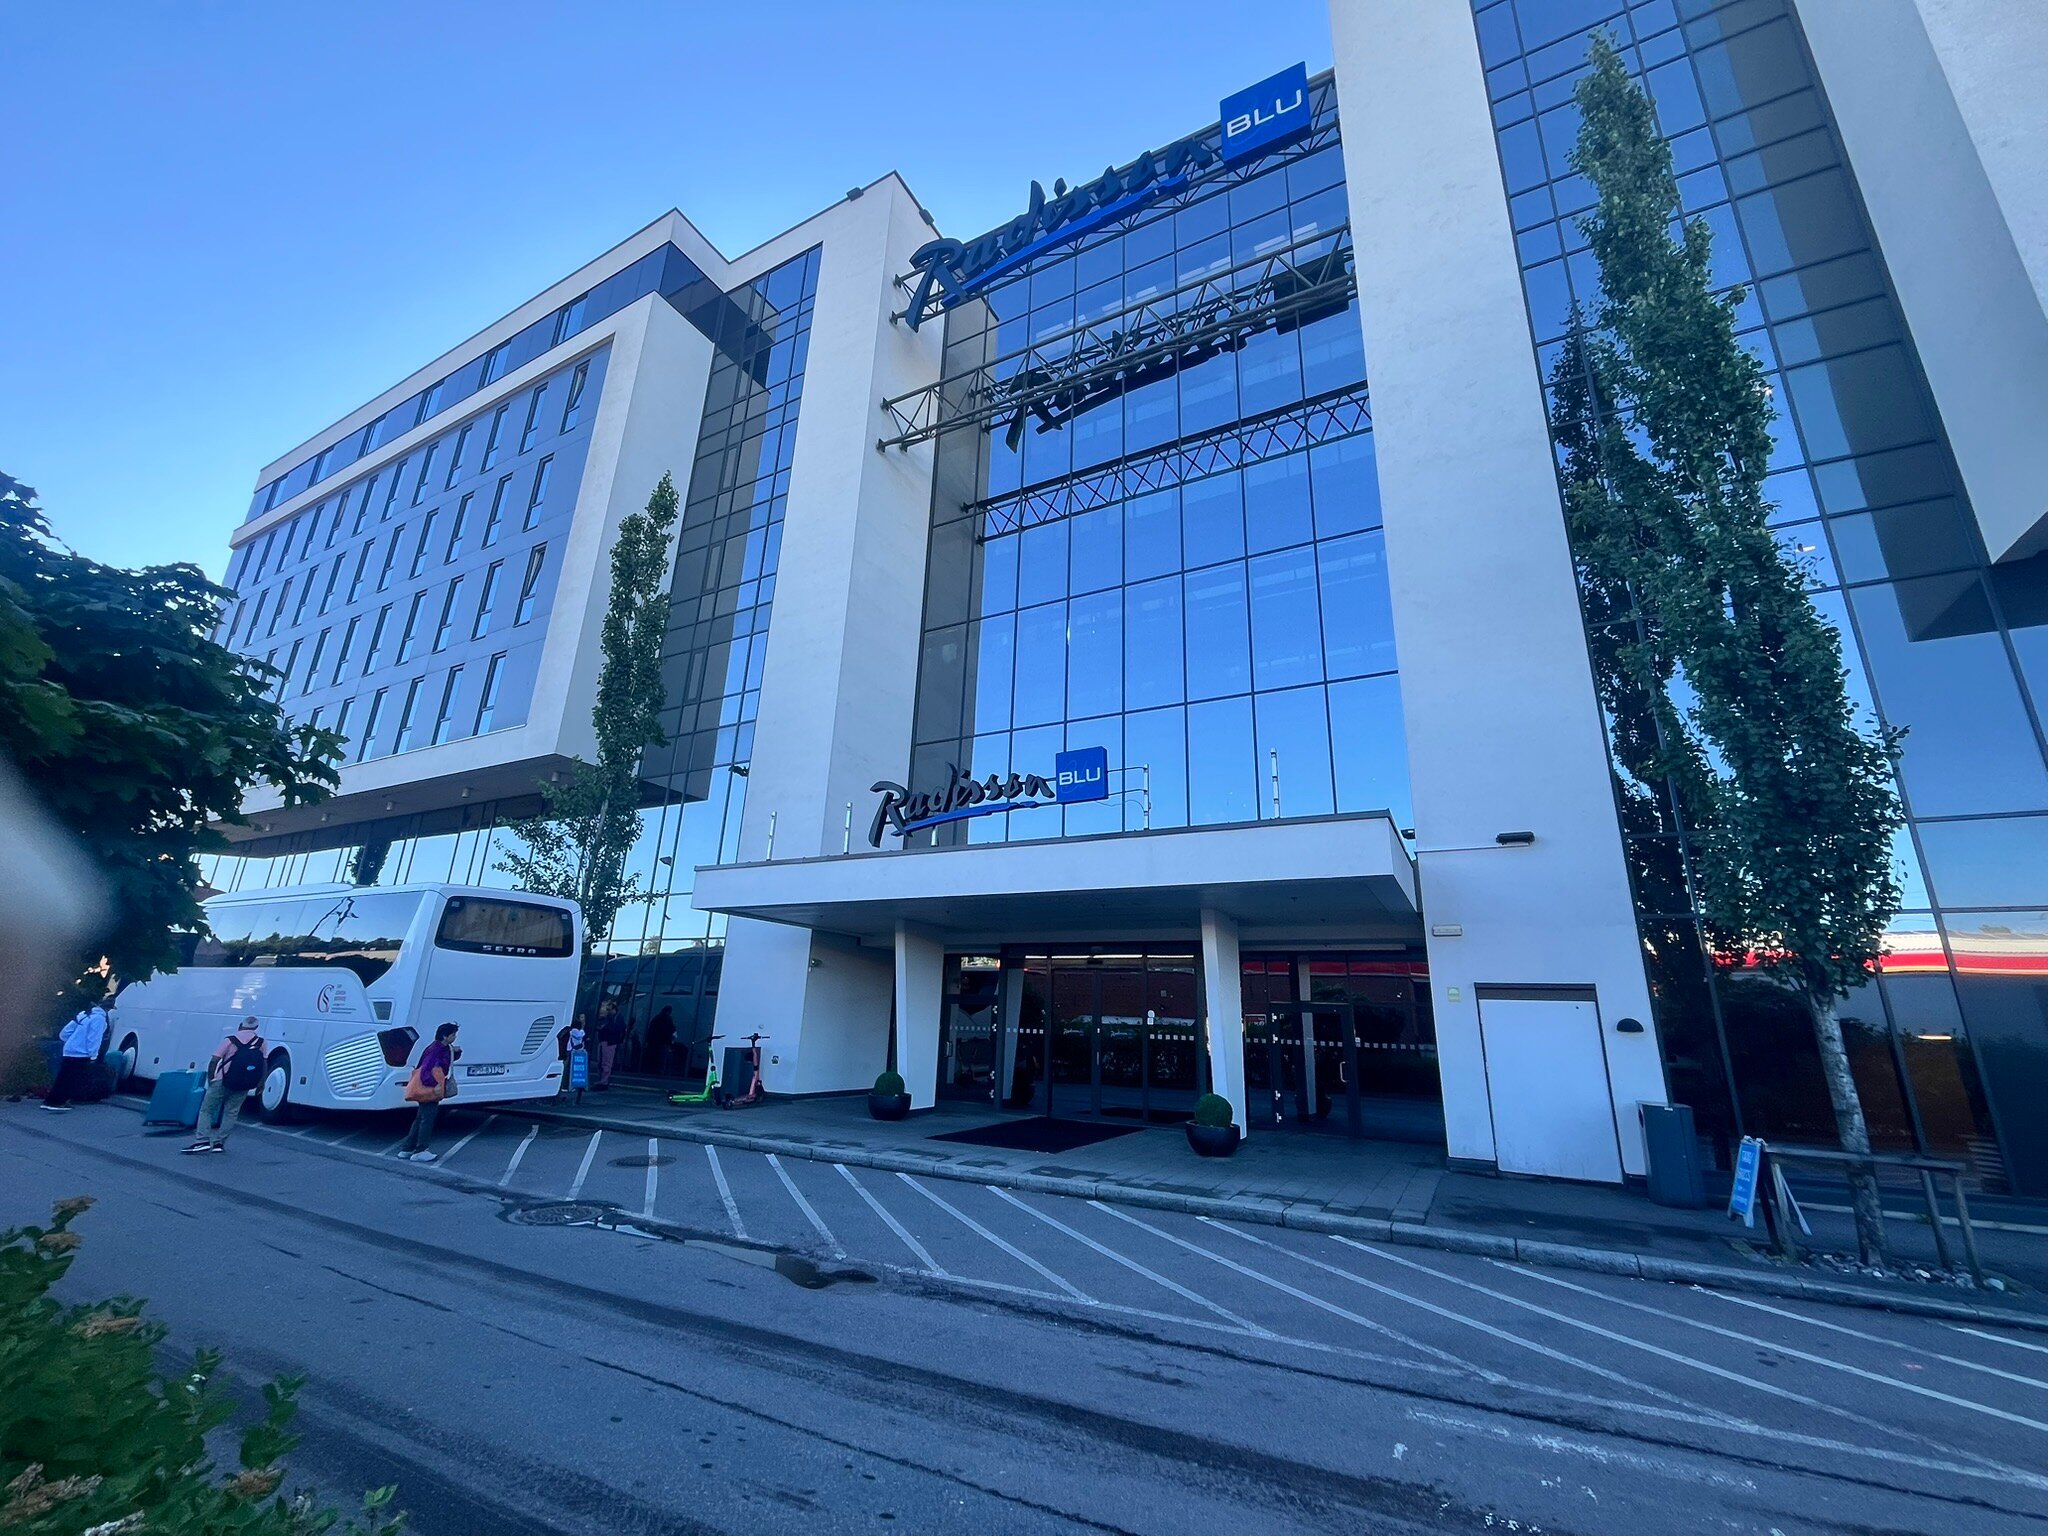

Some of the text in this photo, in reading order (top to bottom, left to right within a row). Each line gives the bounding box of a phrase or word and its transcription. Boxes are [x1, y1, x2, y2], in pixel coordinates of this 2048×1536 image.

[906, 89, 1302, 333] Radisson BLU
[869, 762, 1101, 848] Radisson BLU
[482, 945, 537, 954] SETRA
